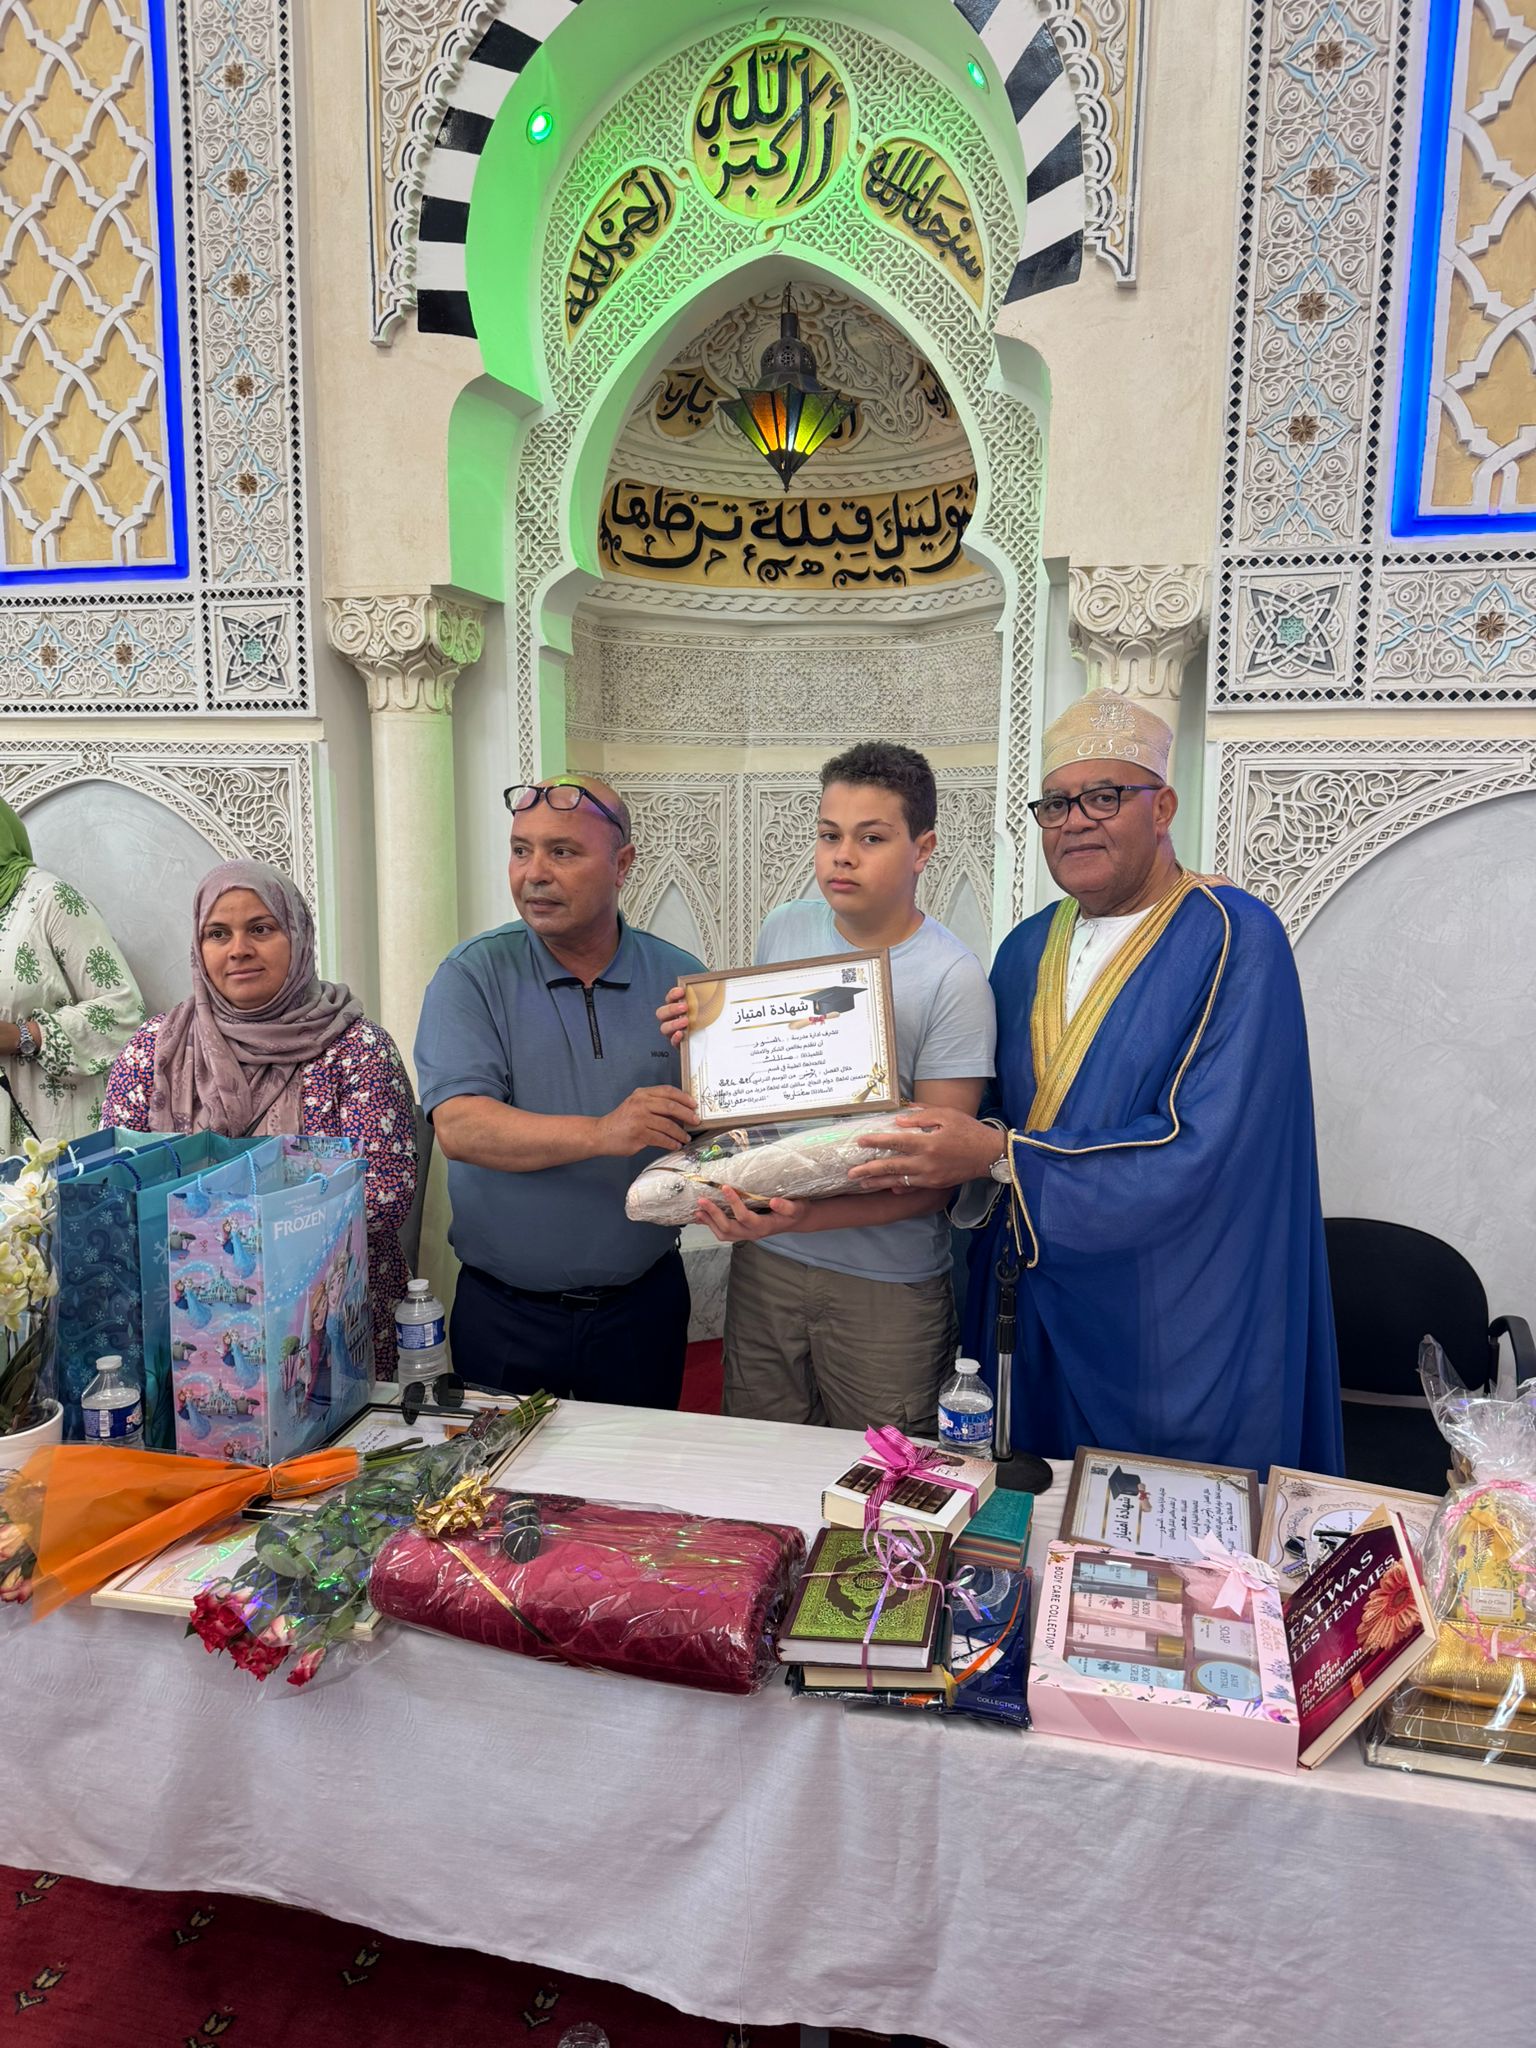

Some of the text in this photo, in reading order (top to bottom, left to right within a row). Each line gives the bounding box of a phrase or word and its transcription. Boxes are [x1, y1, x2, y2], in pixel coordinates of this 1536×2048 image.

[734, 1000, 809, 1024] شهادة امتياز
[273, 1206, 327, 1241] FROZEN
[1053, 1566, 1064, 1583] BODY
[1050, 1585, 1062, 1603] CARE
[1288, 1550, 1374, 1643] FATWAS
[1142, 1600, 1151, 1616] BODY
[1292, 1629, 1321, 1664] LES
[1323, 1554, 1396, 1632] FEMMES
[1220, 1624, 1231, 1645] SOAP
[1141, 1666, 1151, 1684] BODY
[976, 1696, 1021, 1711] COLLECTION
[1302, 1695, 1316, 1712] Ibn
